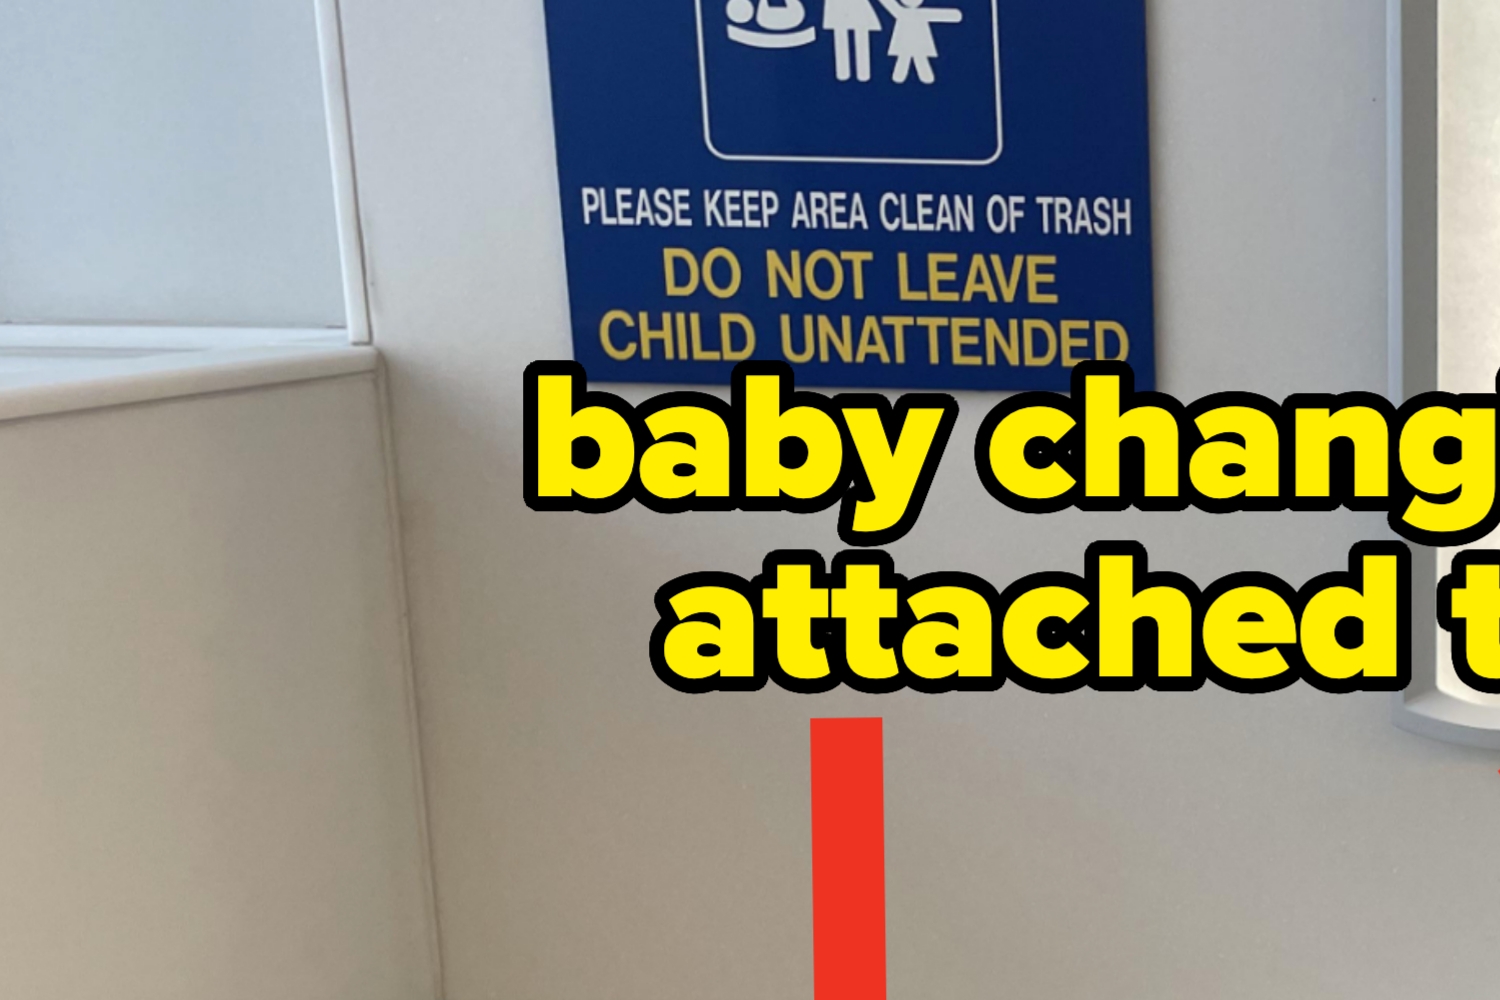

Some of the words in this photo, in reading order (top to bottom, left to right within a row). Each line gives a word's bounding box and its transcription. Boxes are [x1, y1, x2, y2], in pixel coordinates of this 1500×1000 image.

[581, 187, 693, 228] PLEASE
[703, 189, 780, 229] KEEP
[791, 191, 869, 231] AREA
[879, 192, 974, 233] CLEAN
[986, 194, 1026, 234] OF
[1035, 196, 1132, 236] TRASH
[662, 246, 742, 298] DO
[765, 249, 874, 301] NOT
[896, 252, 1059, 304] LEAVE
[599, 309, 757, 362] CHILD
[780, 314, 1130, 368] UNATTENDED
